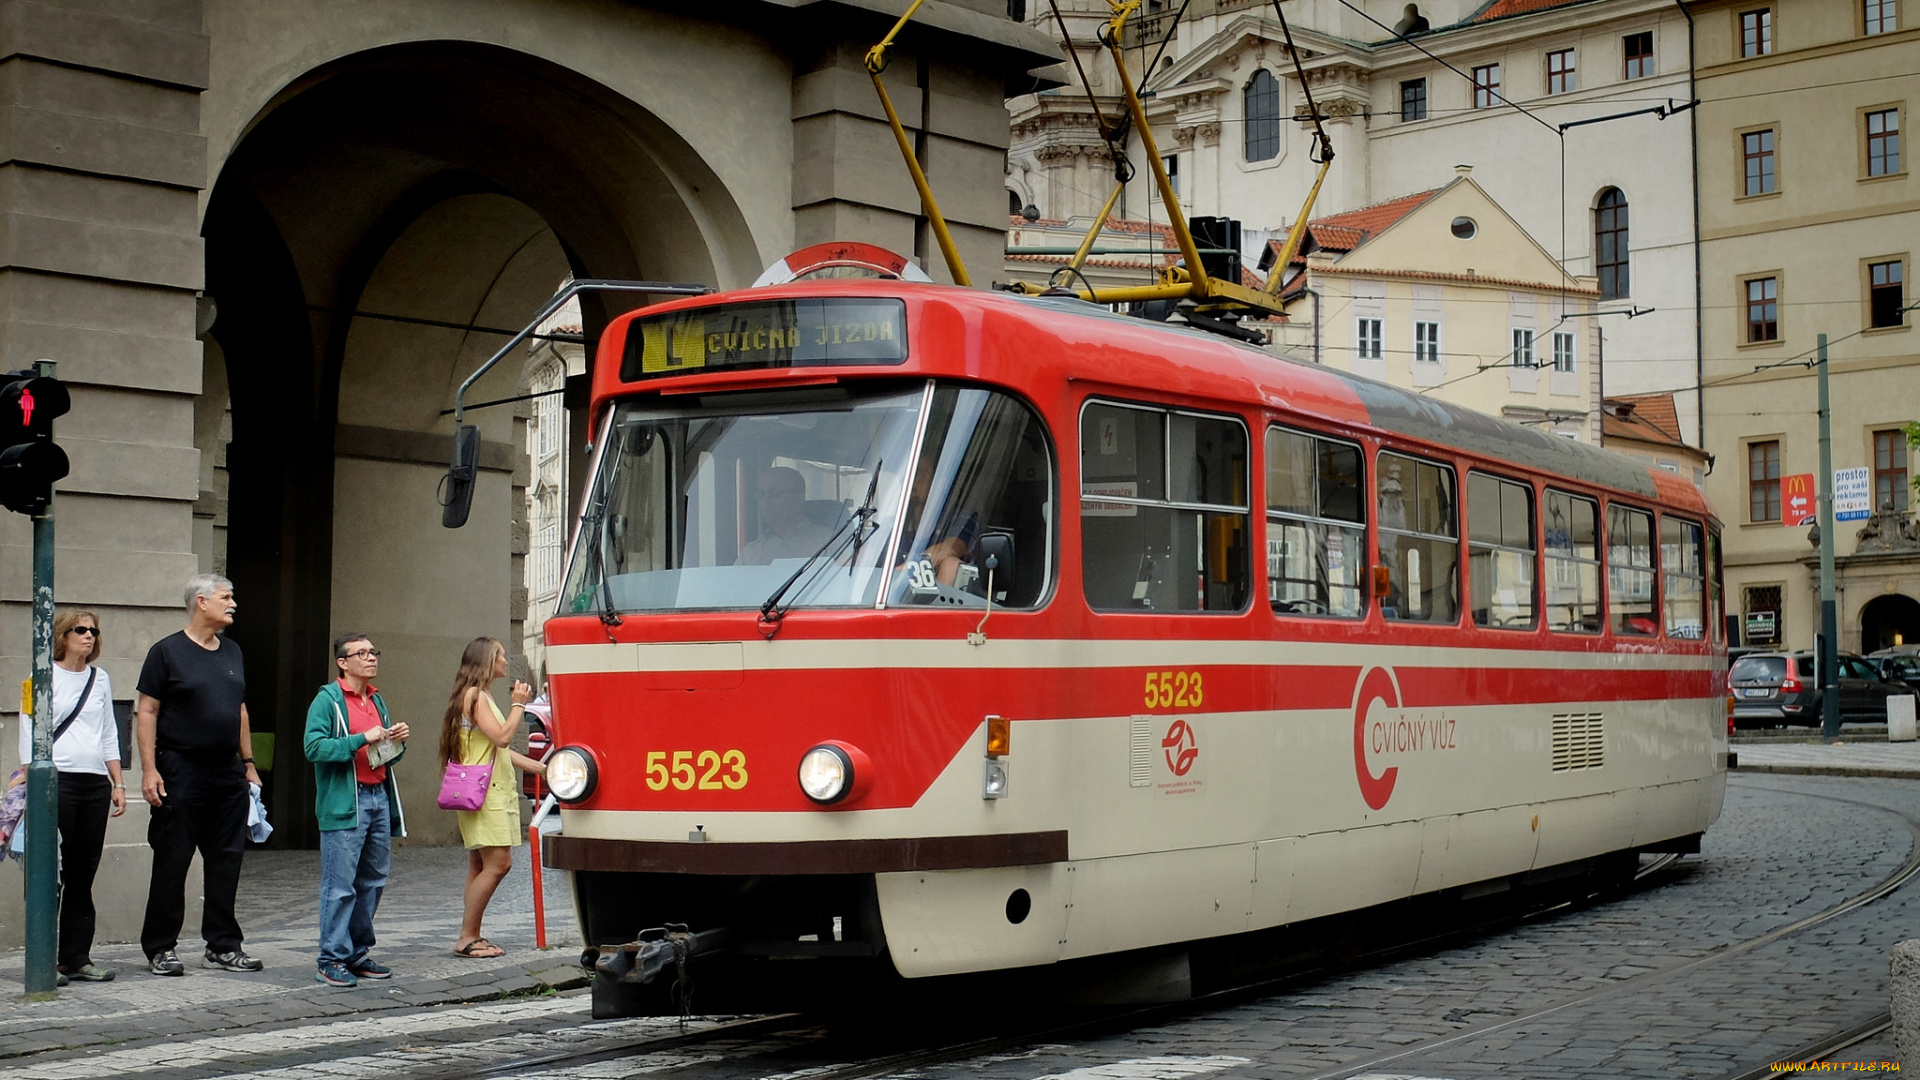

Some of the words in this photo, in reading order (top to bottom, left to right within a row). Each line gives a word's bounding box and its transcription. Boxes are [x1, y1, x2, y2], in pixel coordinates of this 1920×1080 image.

[1836, 468, 1868, 484] prostor
[1836, 491, 1868, 500] reklamu
[907, 559, 936, 588] 36
[1144, 671, 1203, 709] 5523
[1372, 713, 1426, 754] CVIČNÝ
[1429, 711, 1456, 750] VŮZ
[645, 749, 749, 791] 5523
